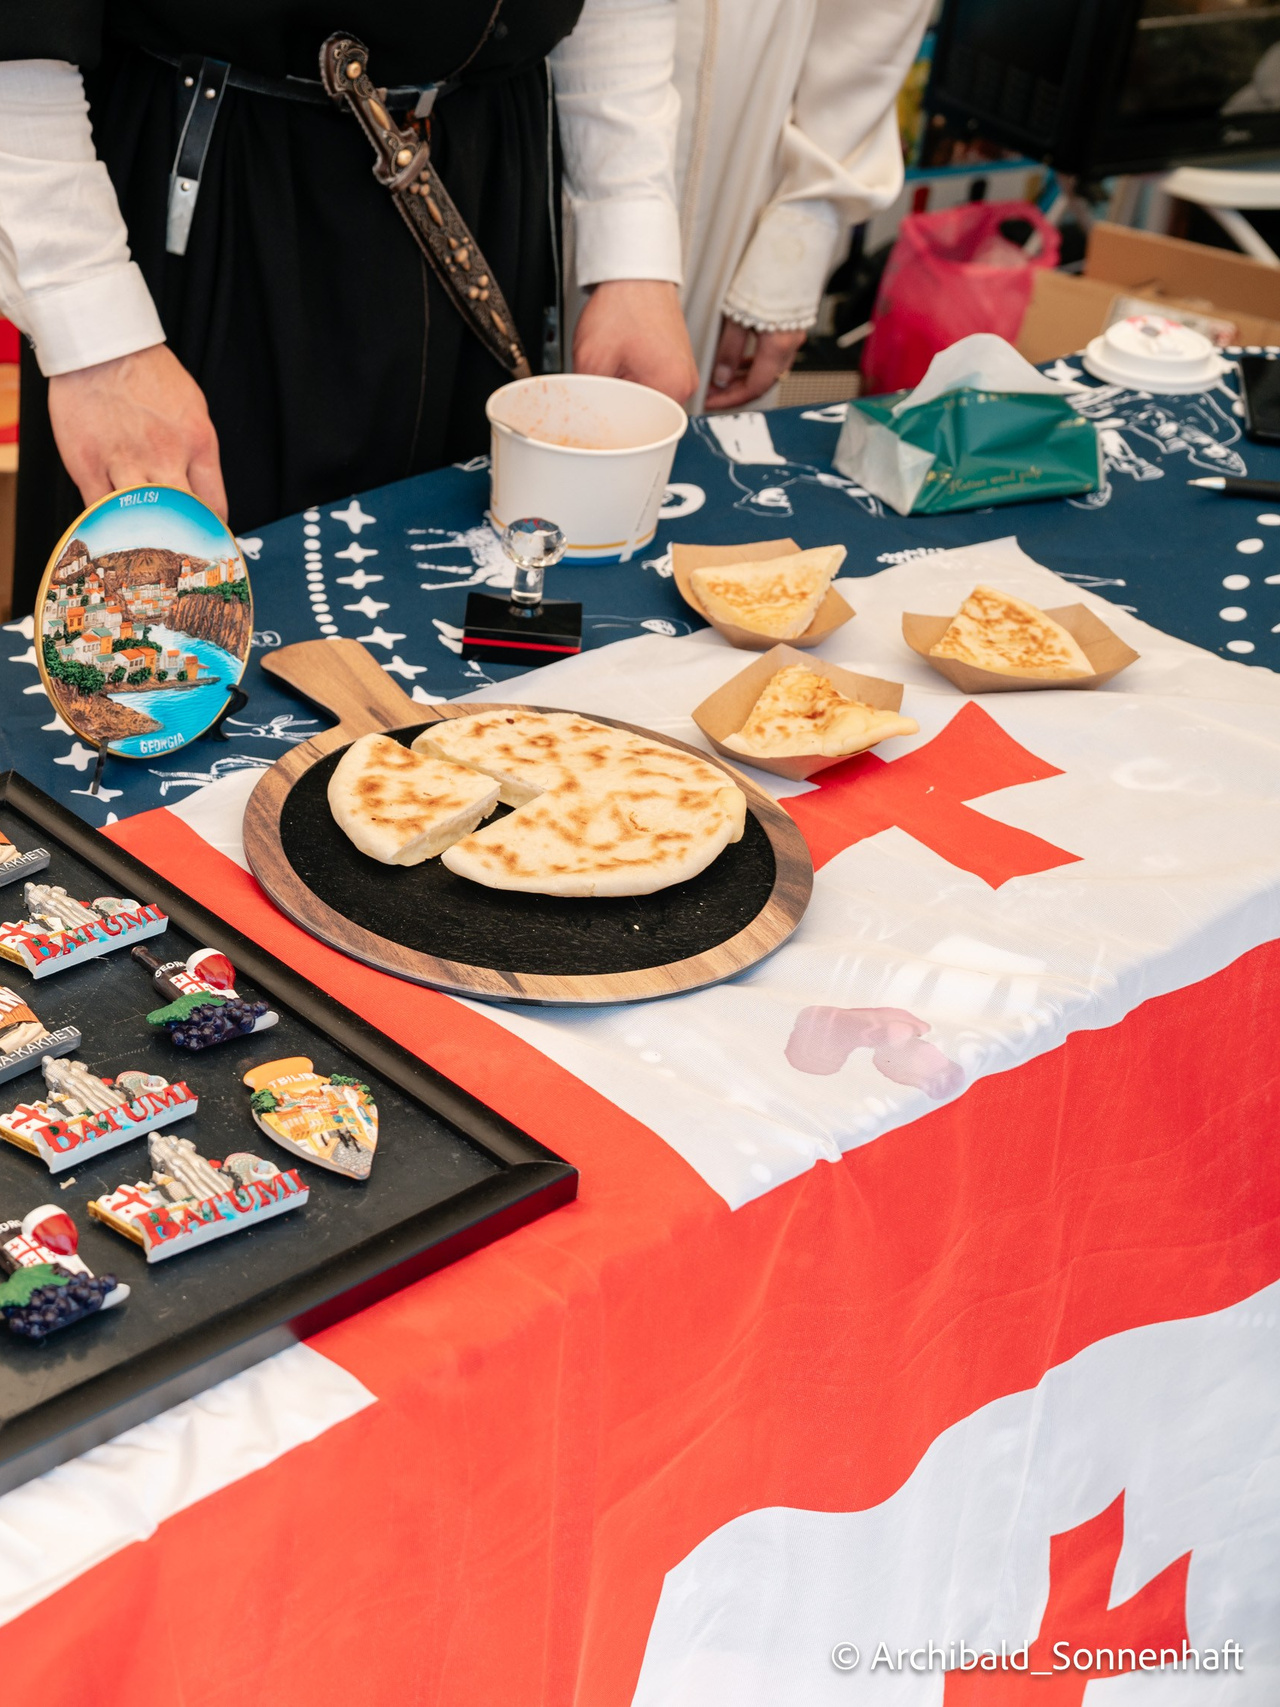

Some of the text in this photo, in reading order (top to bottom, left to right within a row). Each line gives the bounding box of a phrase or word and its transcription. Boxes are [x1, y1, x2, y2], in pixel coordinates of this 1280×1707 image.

[119, 491, 159, 507] TBILISI
[140, 733, 185, 754] GEORGIA
[19, 904, 168, 966] BATUMI
[268, 1073, 318, 1088] TBILISI
[34, 1081, 198, 1153] BATUMI
[133, 1168, 309, 1249] BATUMI
